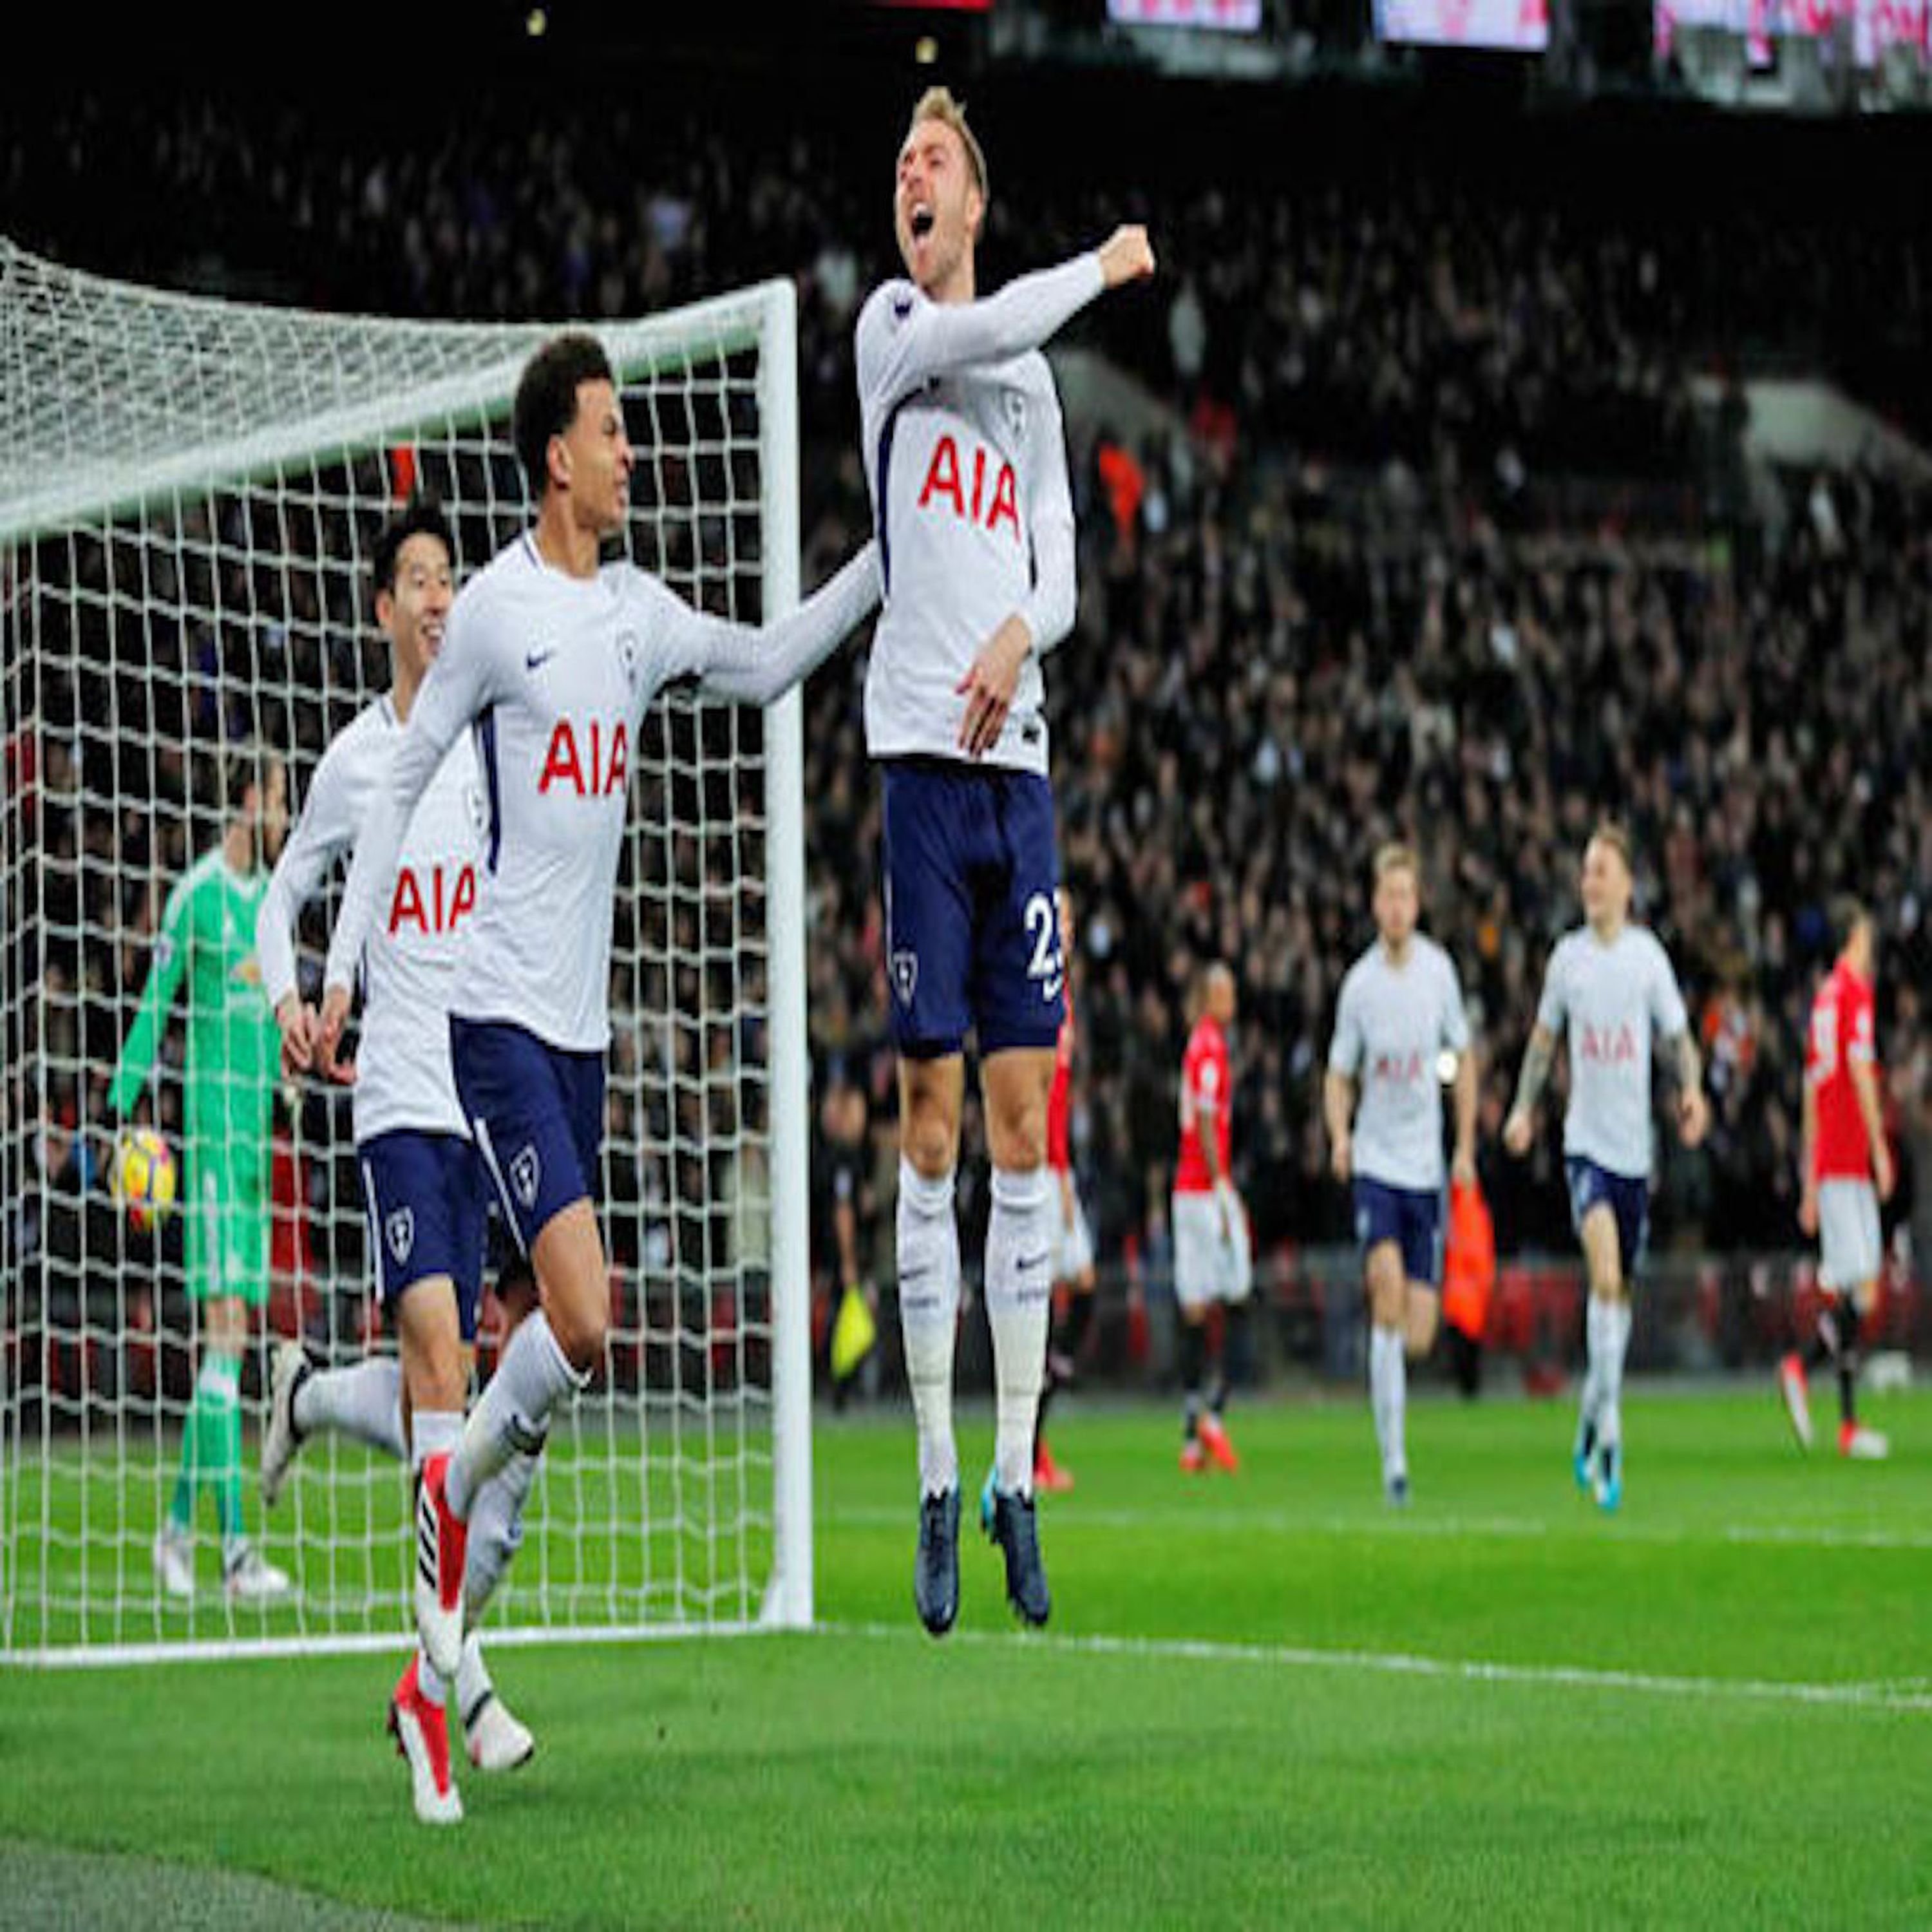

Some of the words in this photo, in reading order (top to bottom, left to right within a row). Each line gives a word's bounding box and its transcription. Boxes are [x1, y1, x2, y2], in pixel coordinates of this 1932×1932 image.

[917, 433, 1021, 543] AIA
[537, 717, 628, 797] AIA
[388, 864, 477, 936] AIA
[1025, 887, 1064, 980] 2
